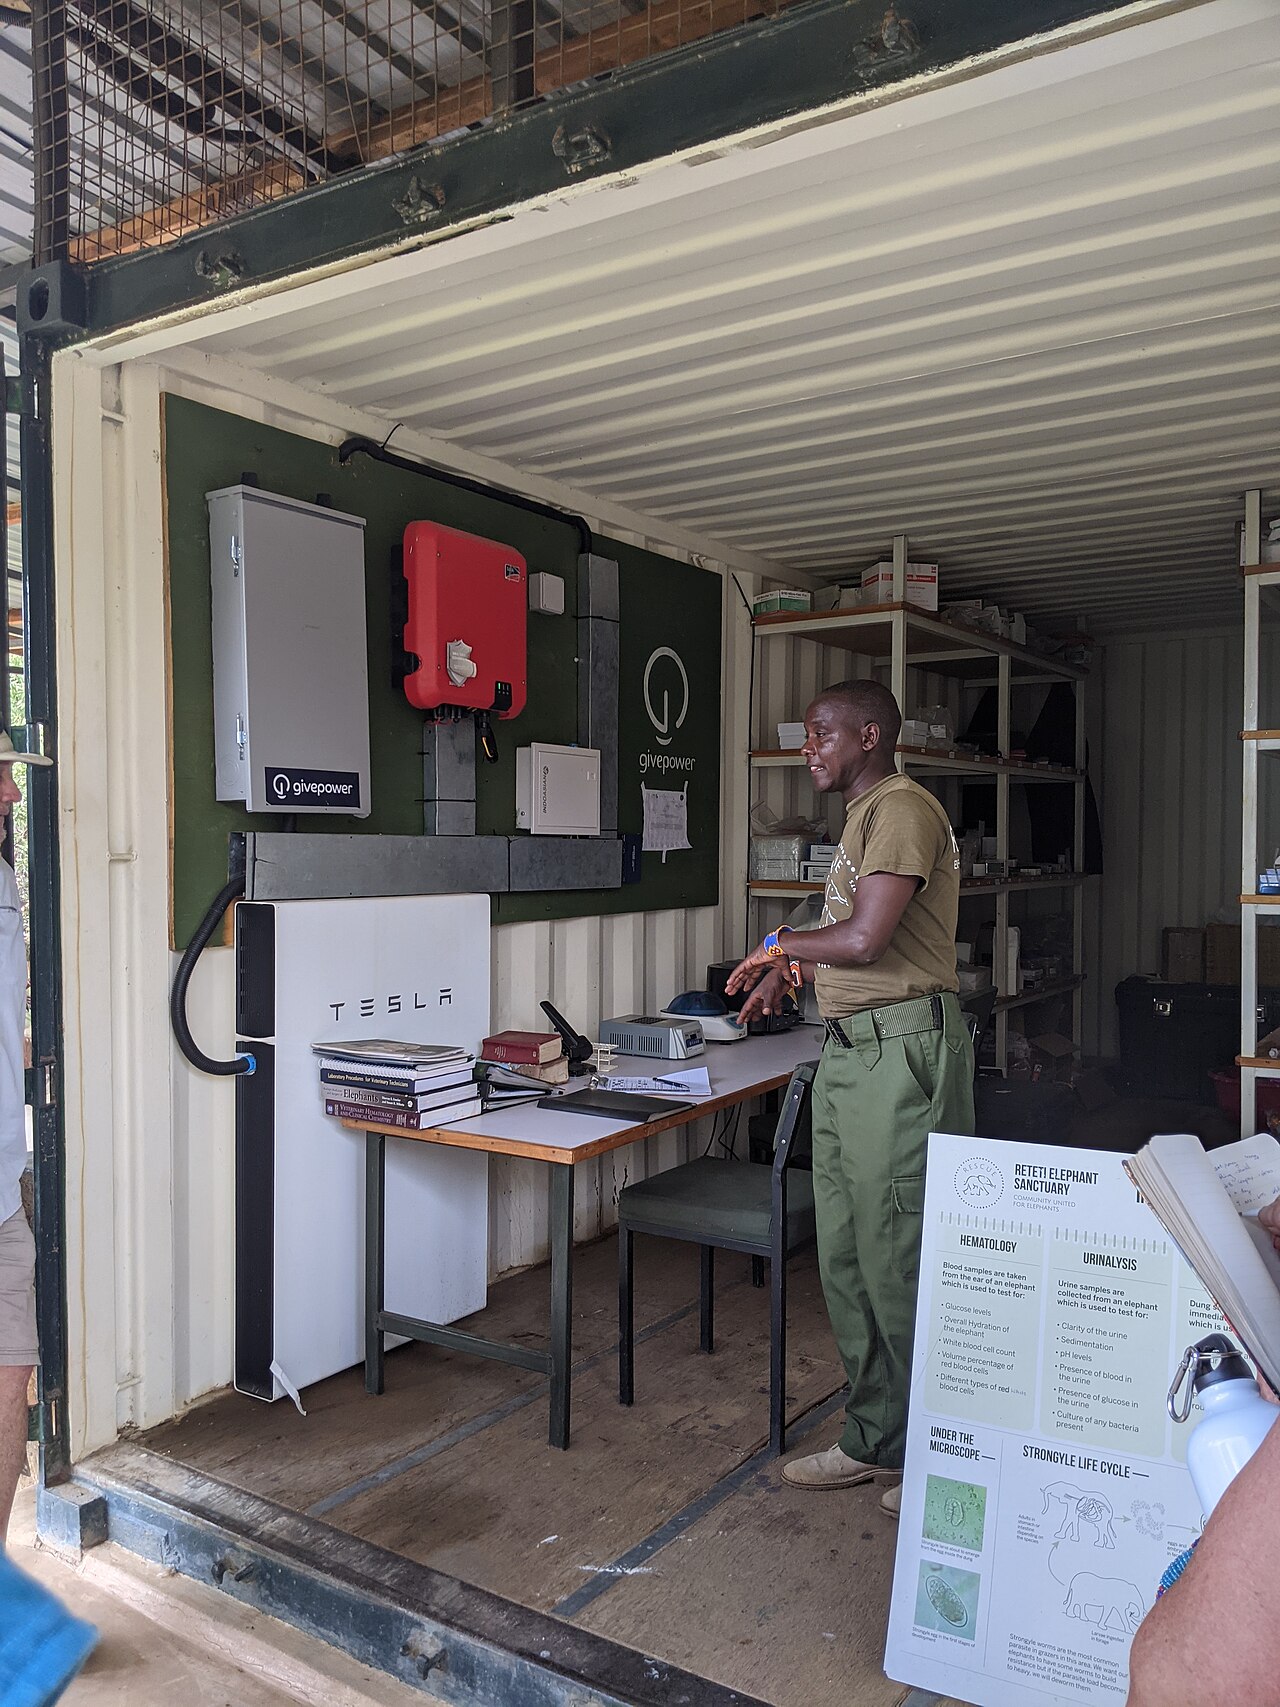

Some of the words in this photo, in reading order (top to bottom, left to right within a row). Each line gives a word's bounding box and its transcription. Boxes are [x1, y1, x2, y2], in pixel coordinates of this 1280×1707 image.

[640, 749, 696, 774] givepower
[293, 779, 353, 796] givepower
[330, 988, 452, 1022] TESLA
[344, 1089, 379, 1102] Elephants
[963, 1162, 997, 1177] RESCUE
[1049, 1168, 1098, 1185] ELEPHANT
[1014, 1178, 1069, 1196] SANCTUARY
[1013, 1194, 1051, 1204] COMMUNITY
[1052, 1199, 1076, 1207] UNITED
[1026, 1203, 1060, 1212] ELEPHANTS
[960, 1234, 1017, 1253] HEMATOLOGY
[1083, 1252, 1137, 1271] URINALYSIS
[943, 1262, 962, 1271] Blood
[964, 1267, 992, 1276] samples
[1006, 1272, 1026, 1281] taken
[942, 1270, 958, 1279] from
[1004, 1281, 1035, 1291] elephant
[1058, 1279, 1078, 1289] Urine
[1079, 1284, 1110, 1294] samples
[941, 1280, 961, 1288] which
[962, 1282, 968, 1290] is
[997, 1288, 1011, 1296] test
[1012, 1290, 1025, 1299] for:
[1057, 1290, 1091, 1301] collected
[1093, 1294, 1111, 1304] from
[1124, 1300, 1158, 1311] elephant
[1057, 1299, 1078, 1308] which
[1088, 1304, 1106, 1312] used
[1108, 1306, 1116, 1314] to
[1118, 1308, 1133, 1316] test
[1135, 1310, 1148, 1319] for:
[1190, 1300, 1211, 1311] Dung
[945, 1303, 971, 1313] Glucose
[972, 1307, 991, 1316] levels
[943, 1325, 954, 1333] the
[955, 1327, 984, 1338] elephant
[944, 1316, 967, 1326] Overall
[968, 1320, 1001, 1332] Hydration
[1061, 1322, 1086, 1334] Clarity
[1085, 1326, 1093, 1334] of
[1095, 1328, 1107, 1336] the
[1108, 1331, 1127, 1339] urine
[1189, 1320, 1212, 1329] which
[942, 1338, 961, 1347] White
[962, 1341, 982, 1351] blood
[995, 1349, 1015, 1357] count
[1060, 1336, 1113, 1351] Sedimentation
[941, 1351, 966, 1362] Volume
[967, 1357, 1005, 1370] percentage
[1059, 1351, 1070, 1359] pH
[1072, 1352, 1092, 1362] levels
[953, 1363, 973, 1372] blood
[972, 1367, 988, 1375] cells
[1059, 1363, 1092, 1376] Presence
[1093, 1370, 1101, 1378] of
[1102, 1371, 1123, 1382] blood
[1125, 1375, 1132, 1383] in
[940, 1374, 969, 1385] Different
[970, 1380, 988, 1389] types
[1058, 1374, 1070, 1382] the
[1071, 1377, 1090, 1385] urine
[939, 1382, 958, 1392] blood
[959, 1387, 974, 1395] cells
[1057, 1397, 1069, 1405] the
[1070, 1400, 1089, 1408] urine
[1058, 1387, 1091, 1399] Presence
[1101, 1395, 1130, 1406] glucose
[1131, 1400, 1138, 1408] in
[1056, 1411, 1083, 1422] Culture
[1084, 1416, 1092, 1424] of
[1093, 1419, 1107, 1428] any
[1108, 1420, 1139, 1432] bacteria
[1056, 1421, 1083, 1431] present
[931, 1426, 957, 1441] UNDER
[959, 1432, 974, 1445] THE
[929, 1440, 980, 1461] MICROSCOPE
[1023, 1445, 1076, 1468] STRONGYLE
[1078, 1457, 1098, 1472] LIFE
[1100, 1461, 1130, 1478] CYCLE
[1009, 1633, 1036, 1646] Strongyle
[1037, 1642, 1056, 1651] worms
[1077, 1652, 1092, 1660] most
[1093, 1656, 1119, 1667] common
[1008, 1649, 1035, 1661] elephants
[1043, 1657, 1056, 1666] have
[1057, 1662, 1073, 1671] some
[1074, 1667, 1094, 1677] worms
[1101, 1673, 1116, 1683] build
[1008, 1657, 1036, 1669] resistance
[1036, 1663, 1046, 1672] but
[1052, 1668, 1061, 1676] the
[1062, 1672, 1085, 1682] parasite
[1086, 1677, 1099, 1686] load
[1100, 1681, 1127, 1694] becomes
